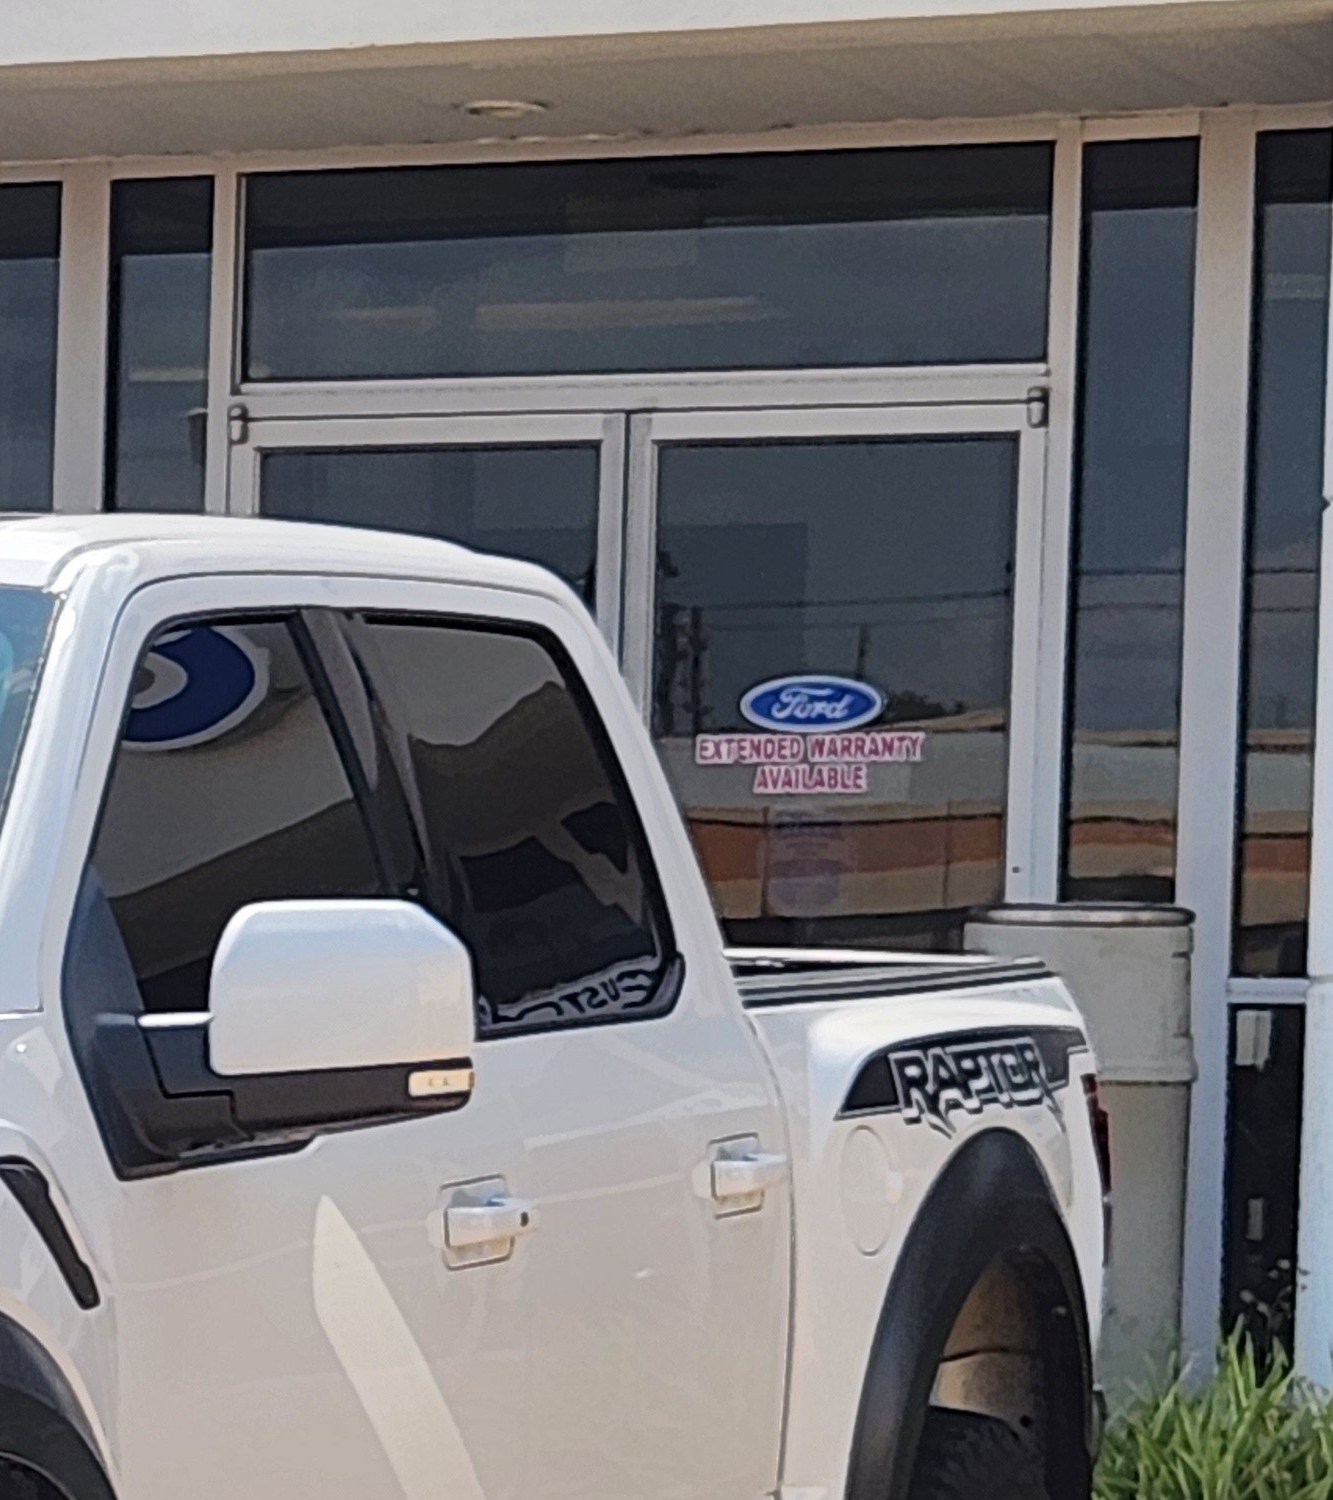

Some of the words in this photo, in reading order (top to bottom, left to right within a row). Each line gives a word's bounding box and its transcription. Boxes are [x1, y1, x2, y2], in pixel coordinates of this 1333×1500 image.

[771, 686, 850, 719] Ford
[699, 739, 802, 760] EXTENDED
[809, 735, 922, 759] WARRANTY
[756, 766, 865, 789] AVAILABLE
[888, 1036, 1067, 1139] RAPTOR
